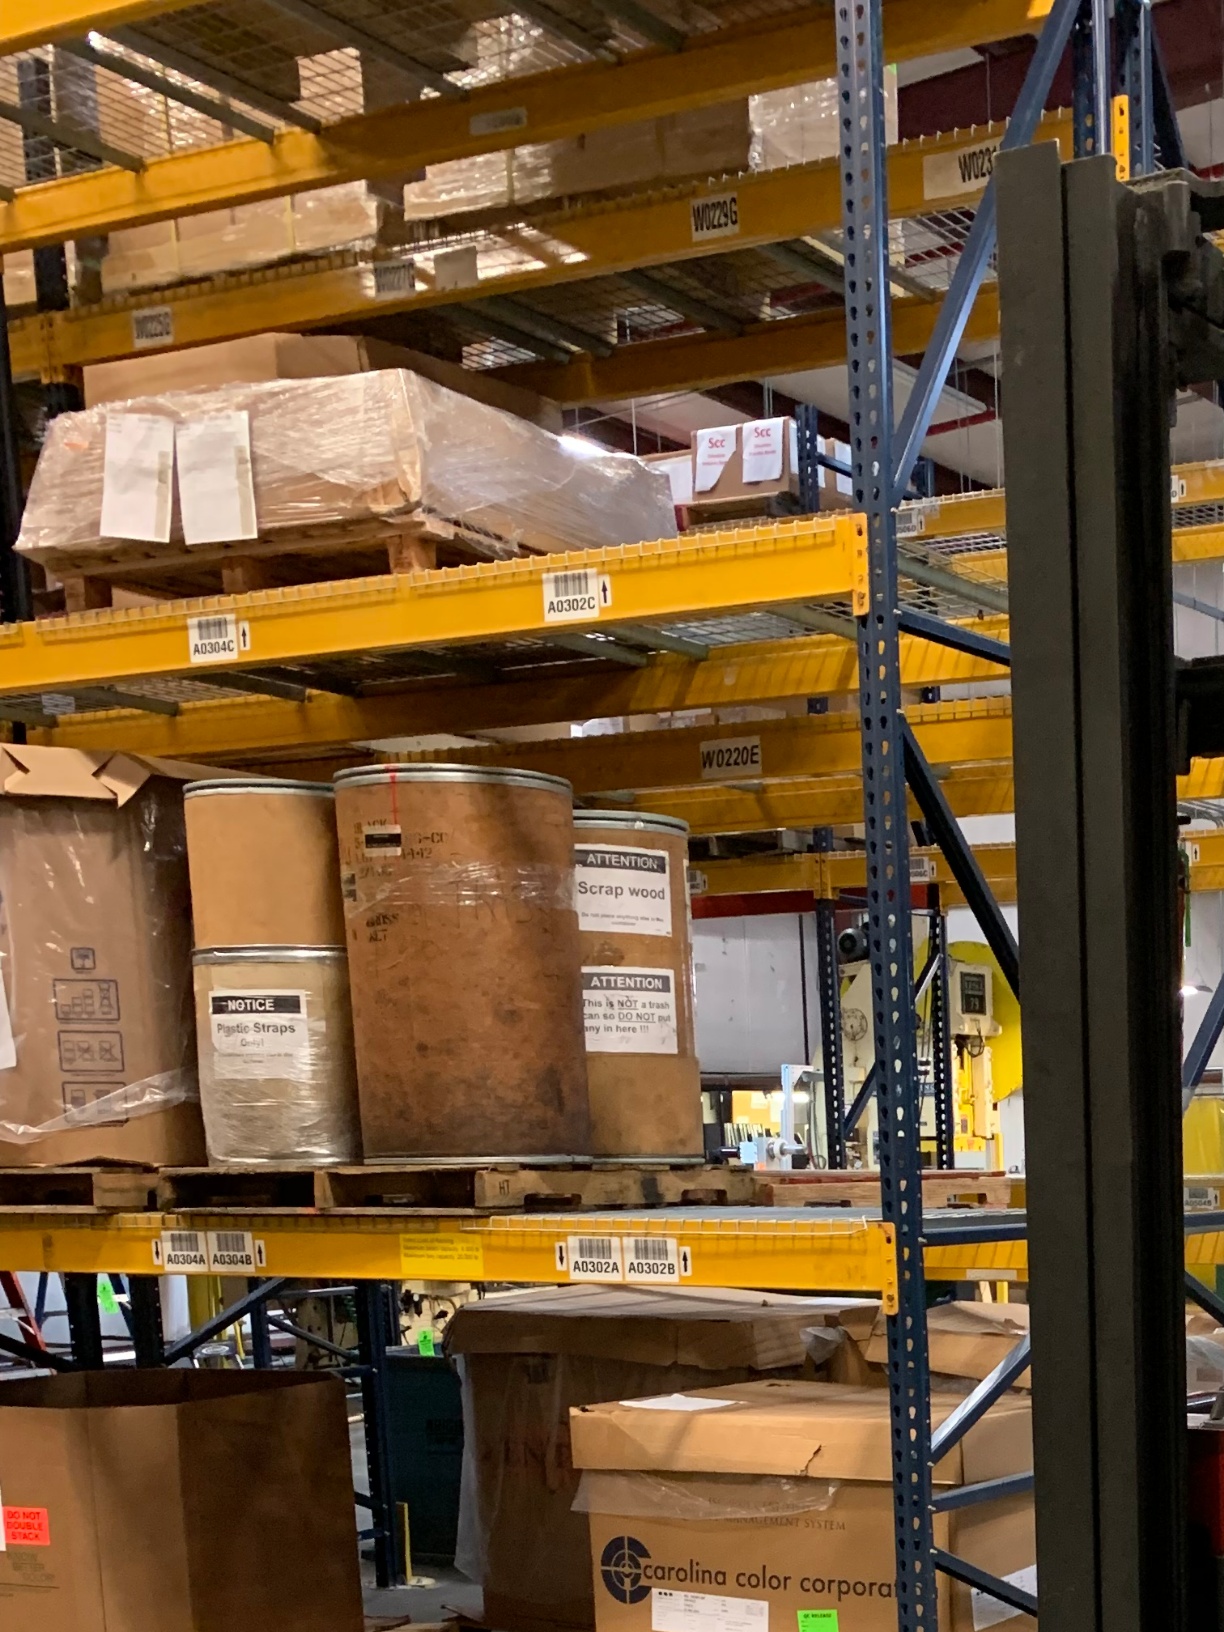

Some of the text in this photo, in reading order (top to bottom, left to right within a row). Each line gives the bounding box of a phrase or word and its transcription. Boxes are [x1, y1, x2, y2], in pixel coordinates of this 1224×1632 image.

[958, 146, 997, 183] W023
[692, 197, 738, 232] W0229G
[547, 596, 596, 614] A0302C
[193, 639, 235, 656] A0304C
[701, 744, 760, 769] W0220E
[586, 853, 659, 870] ATTENTION
[578, 881, 665, 900] Scrap wood
[590, 976, 663, 989] ATTENTION
[228, 999, 275, 1011] NOTICE
[606, 999, 614, 1008] is
[617, 999, 638, 1010] NOT
[649, 1001, 670, 1009] trash
[618, 1012, 633, 1022] DO
[636, 1013, 656, 1023] NOT
[658, 1014, 671, 1023] put
[217, 1022, 296, 1035] Plastic Straps
[604, 1024, 613, 1032] in
[615, 1025, 637, 1033] here
[167, 1253, 206, 1266] A0304A
[213, 1253, 253, 1267] A0304B
[573, 1260, 620, 1274] A0302A
[628, 1261, 675, 1275] A0302B
[7, 1511, 41, 1520] DO NOT
[6, 1521, 43, 1531] DOUBLE
[804, 1519, 846, 1530] SYSTEM
[11, 1532, 39, 1540] STACK
[643, 1558, 727, 1586] carolina
[735, 1564, 791, 1590] color
